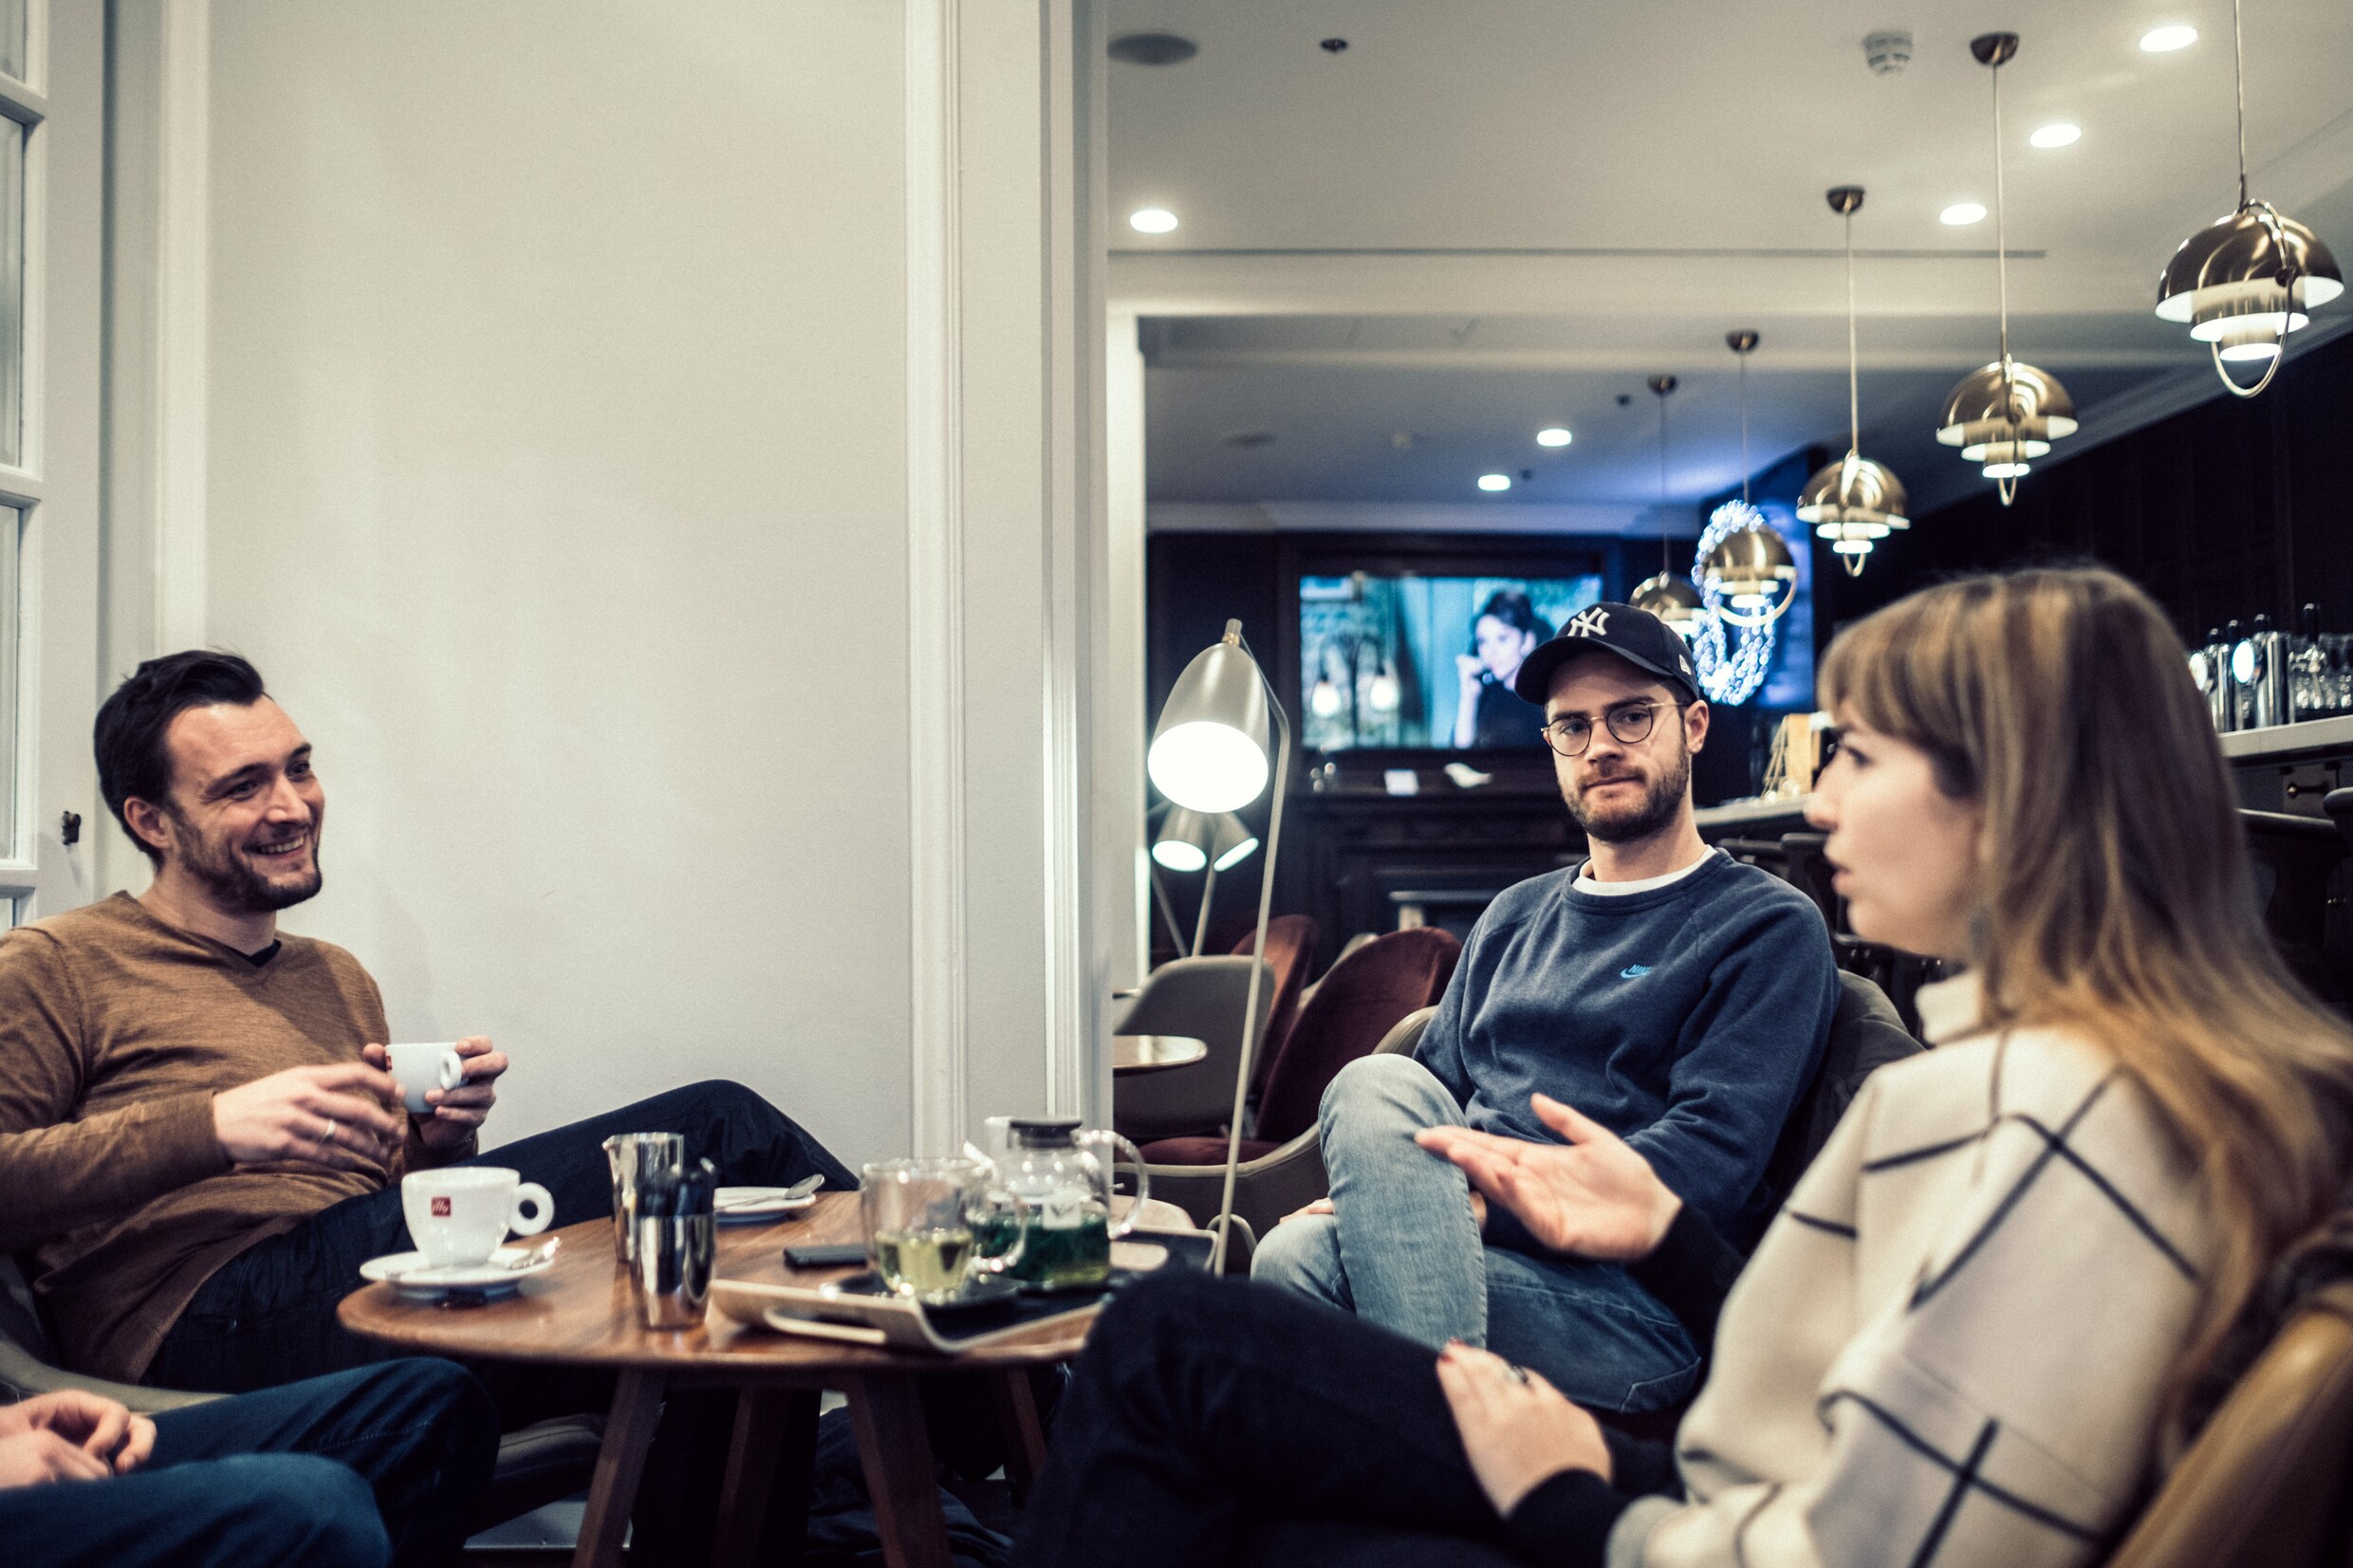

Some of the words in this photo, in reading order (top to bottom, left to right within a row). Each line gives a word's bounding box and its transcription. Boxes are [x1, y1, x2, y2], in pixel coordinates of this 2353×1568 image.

[1567, 607, 1610, 637] NY
[1627, 964, 1652, 975] NIKE
[433, 1199, 450, 1215] illy
